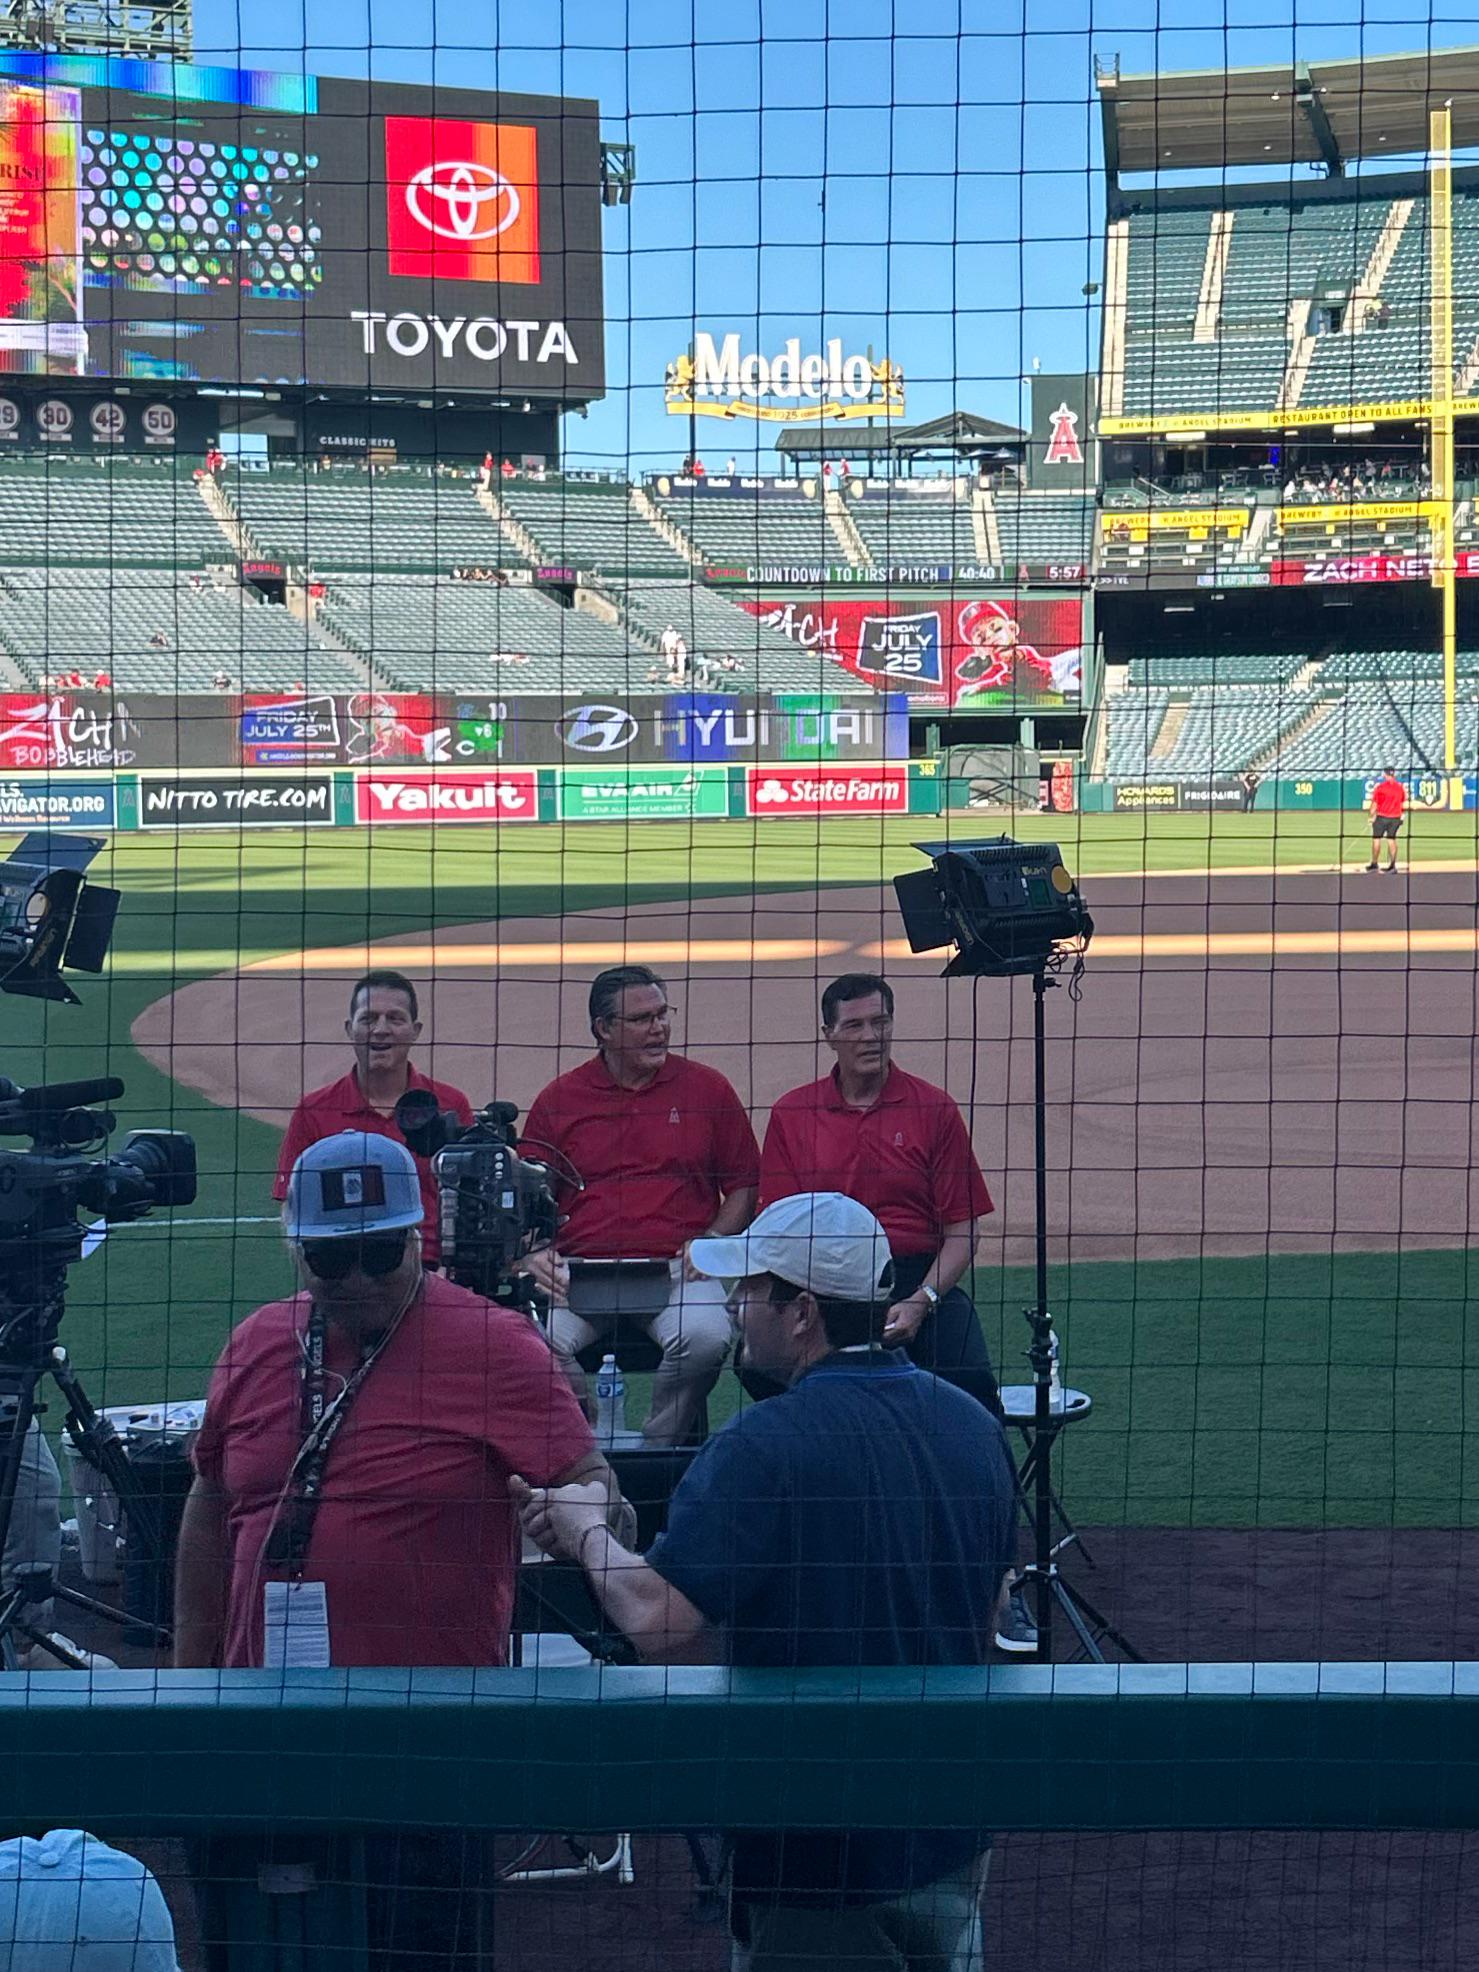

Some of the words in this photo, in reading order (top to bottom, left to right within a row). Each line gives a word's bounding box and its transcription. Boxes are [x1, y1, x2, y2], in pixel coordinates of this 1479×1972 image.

[350, 311, 579, 364] TOYOTA
[695, 332, 873, 398] Modelo
[43, 407, 68, 426] 30
[95, 409, 121, 427] 42
[148, 411, 173, 428] 50
[1273, 411, 1337, 424] RESTAURANT
[1341, 408, 1366, 418] OPEN
[1371, 408, 1381, 417] TO
[1386, 406, 1402, 416] ALL
[1407, 405, 1433, 415] FANS
[319, 436, 367, 446] CLASSIC
[1374, 506, 1412, 515] STADIUM
[746, 566, 831, 582] COUNTDOWN
[835, 567, 852, 582] TO
[856, 567, 895, 582] FIRST
[899, 567, 939, 582] PITCH
[1049, 565, 1081, 580] 5:57
[1303, 562, 1378, 582] ZACH
[872, 634, 934, 651] JULY
[885, 652, 922, 672] 25
[256, 711, 319, 723] FRIDAY
[245, 724, 288, 738] JULY
[148, 787, 218, 810] NITTO
[222, 785, 327, 809] TIRE.COM
[790, 780, 847, 802] State
[848, 779, 900, 802] Farm
[1184, 790, 1240, 800] FRIGIDAIRE
[1294, 782, 1313, 796] 350
